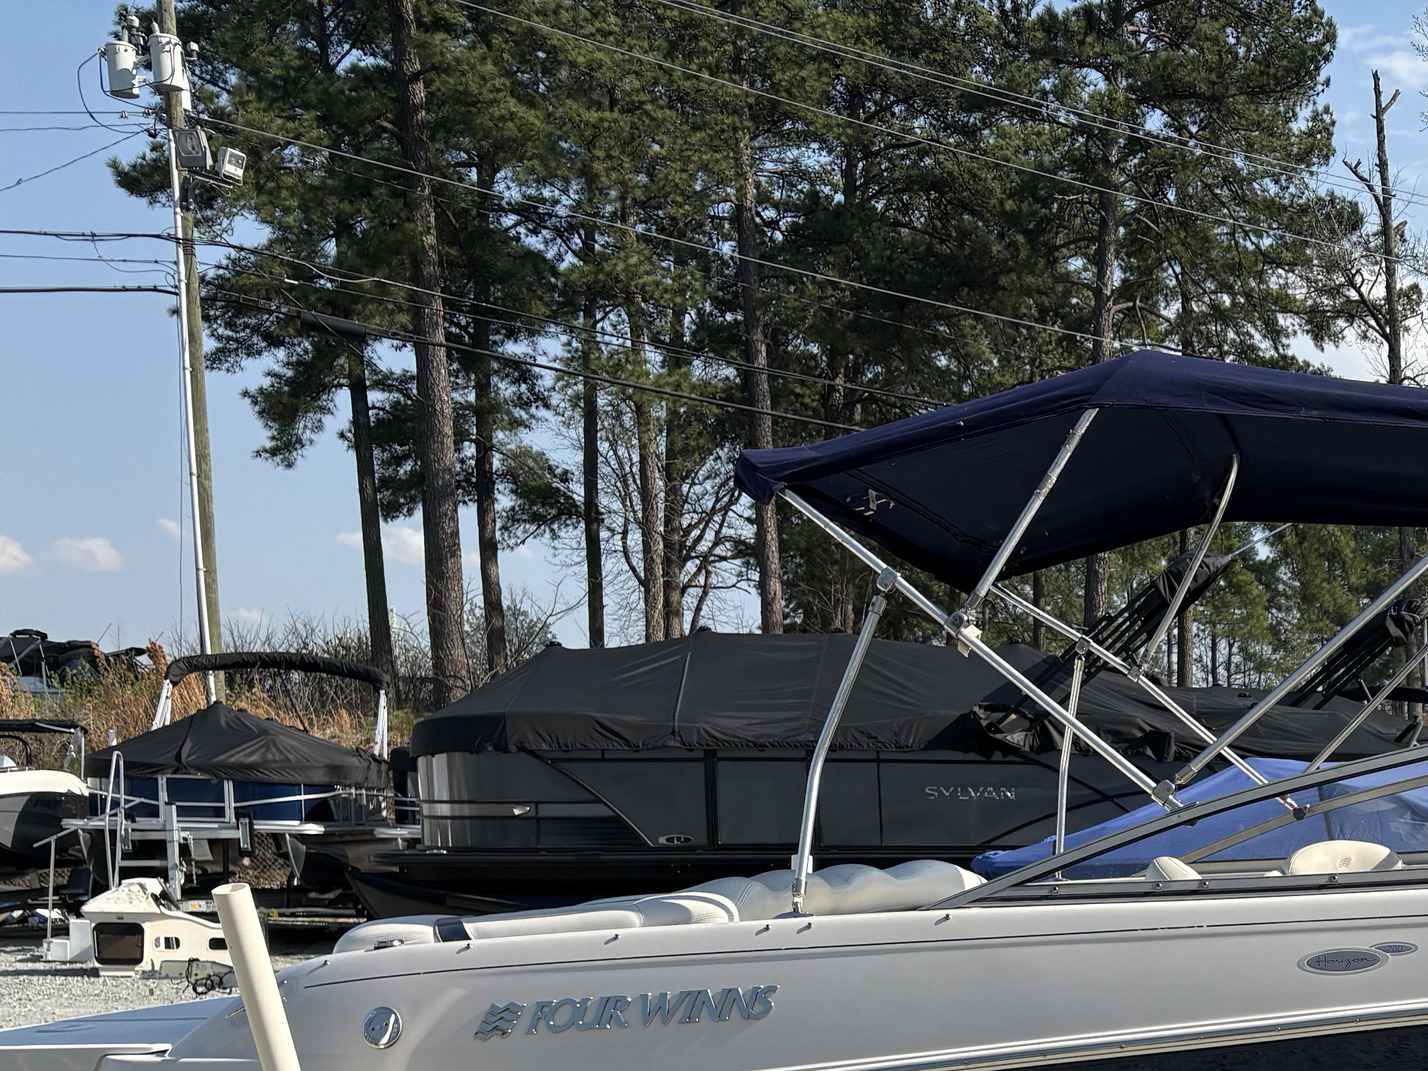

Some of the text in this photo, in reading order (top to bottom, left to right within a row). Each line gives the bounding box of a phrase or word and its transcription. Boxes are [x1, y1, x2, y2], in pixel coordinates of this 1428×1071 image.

[924, 786, 1016, 800] SYLVAN
[526, 984, 781, 1035] FOUR WINNS
